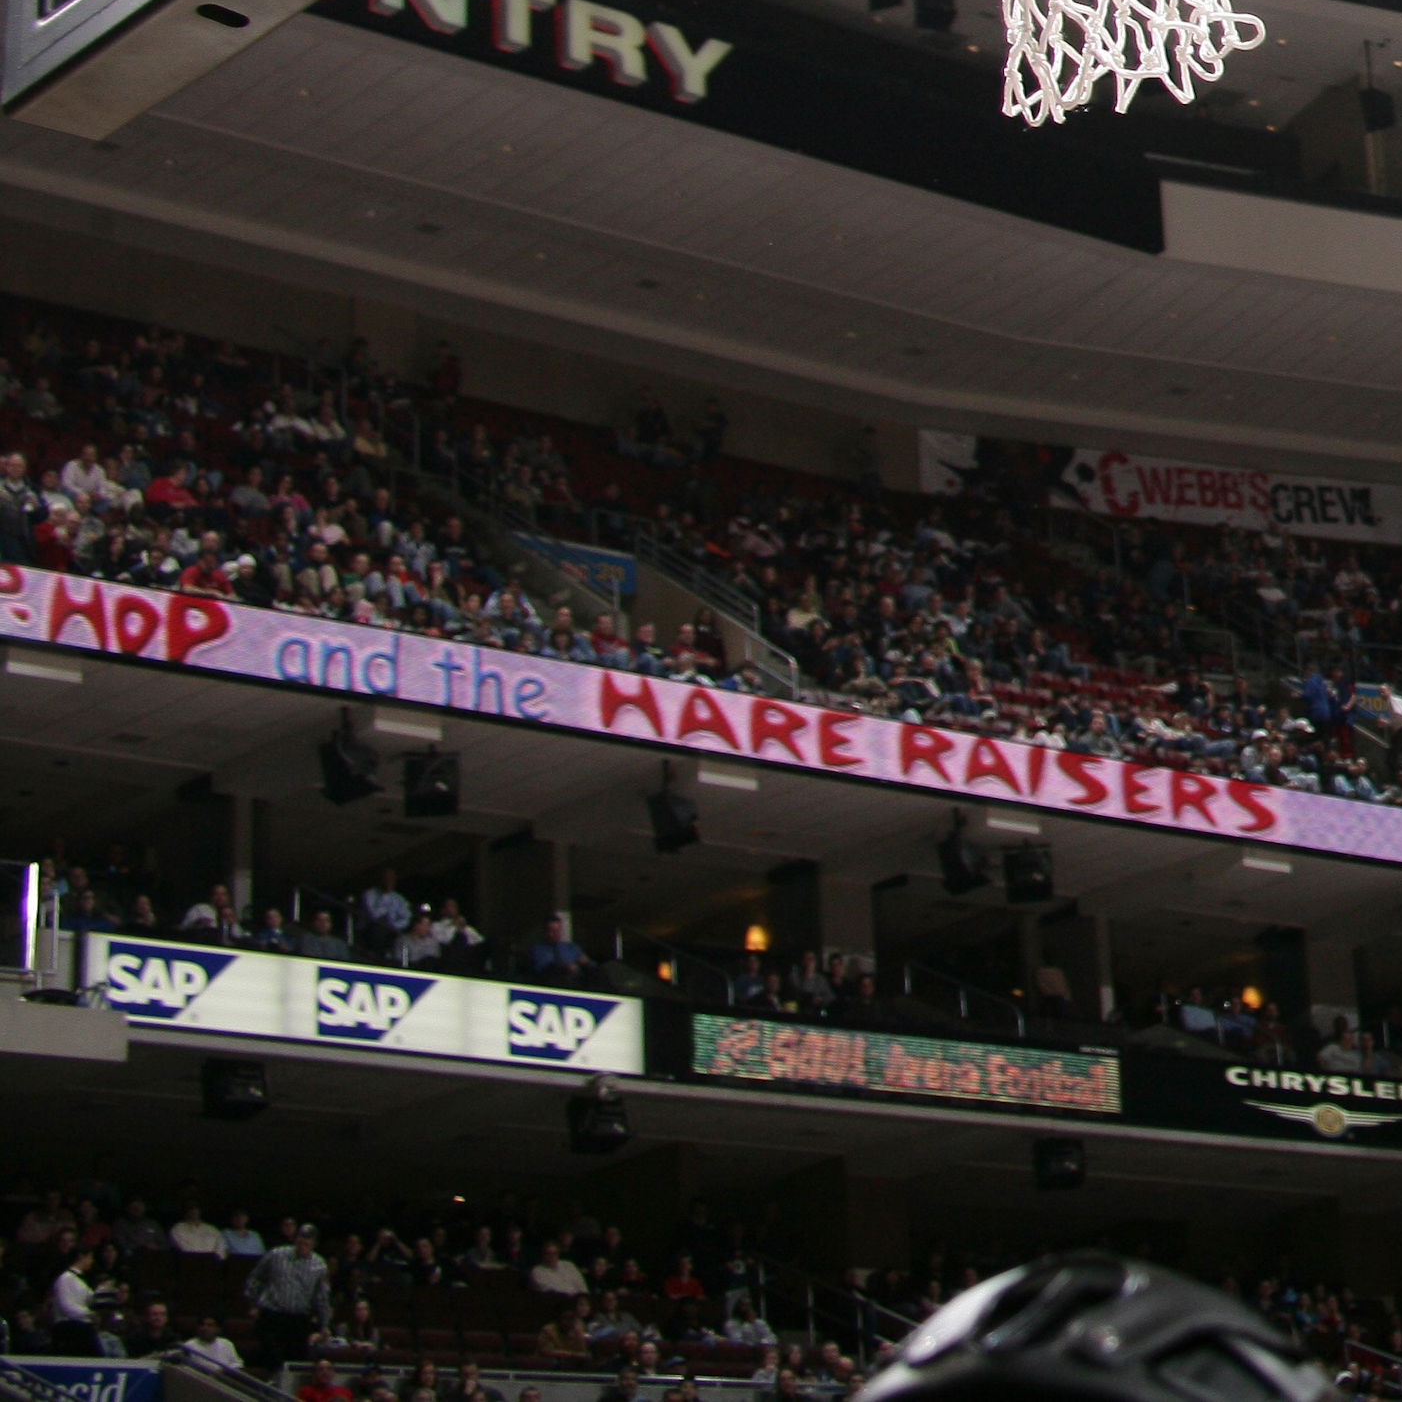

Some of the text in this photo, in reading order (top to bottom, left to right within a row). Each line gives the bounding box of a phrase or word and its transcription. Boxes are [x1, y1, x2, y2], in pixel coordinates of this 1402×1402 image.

[275, 632, 398, 697] and
[431, 647, 548, 721] the
[600, 667, 864, 768] HARE
[901, 721, 1277, 833] RAISERS
[106, 953, 598, 1050] SAP SAP SAP
